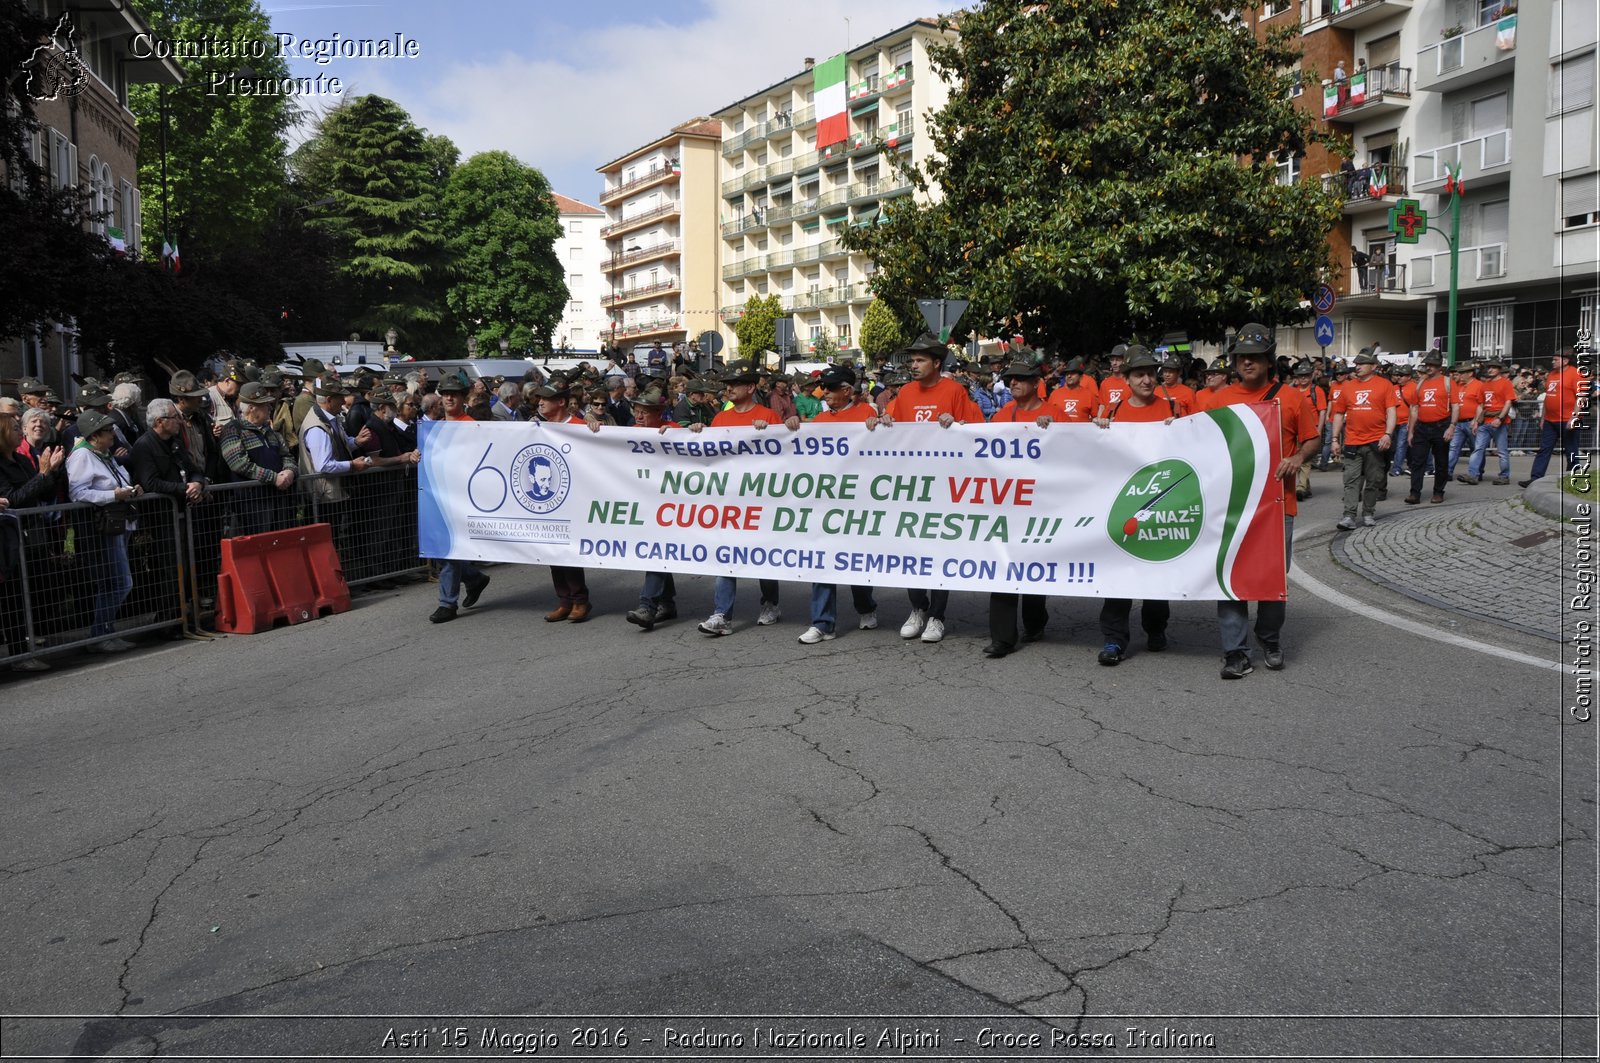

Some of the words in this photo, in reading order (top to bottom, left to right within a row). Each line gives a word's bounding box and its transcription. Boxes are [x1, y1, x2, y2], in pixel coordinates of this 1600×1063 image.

[915, 410, 932, 422] 62
[627, 440, 656, 454] 28
[660, 438, 782, 457] FEBBRAIO
[791, 437, 849, 456] 1956
[974, 438, 1041, 459] 2016
[512, 465, 520, 488] DON
[517, 447, 542, 464] CARLO
[544, 447, 568, 488] GNOCCHI
[660, 470, 729, 496] NON
[739, 471, 859, 500] MUORE
[870, 474, 936, 502] CHI
[948, 476, 1036, 506] VIVE
[519, 495, 536, 511] 1956
[545, 496, 563, 511] 2016
[468, 521, 476, 529] 60
[477, 522, 496, 530] ANNI
[499, 522, 523, 531] DALLA
[525, 523, 540, 532] SUA
[588, 500, 644, 526] NEL
[656, 502, 763, 531] CUORE
[772, 506, 813, 533] DI
[822, 507, 886, 536] CHI
[895, 511, 1009, 543] RESTA
[484, 529, 508, 537] GIORNO
[1138, 527, 1190, 541] ALPINI
[579, 539, 627, 558] DON
[634, 541, 708, 563] CARLO
[715, 545, 826, 570] GNOCCHI
[834, 551, 934, 577] SEMPRE
[942, 558, 997, 580] CON
[1006, 561, 1058, 583] NOI
